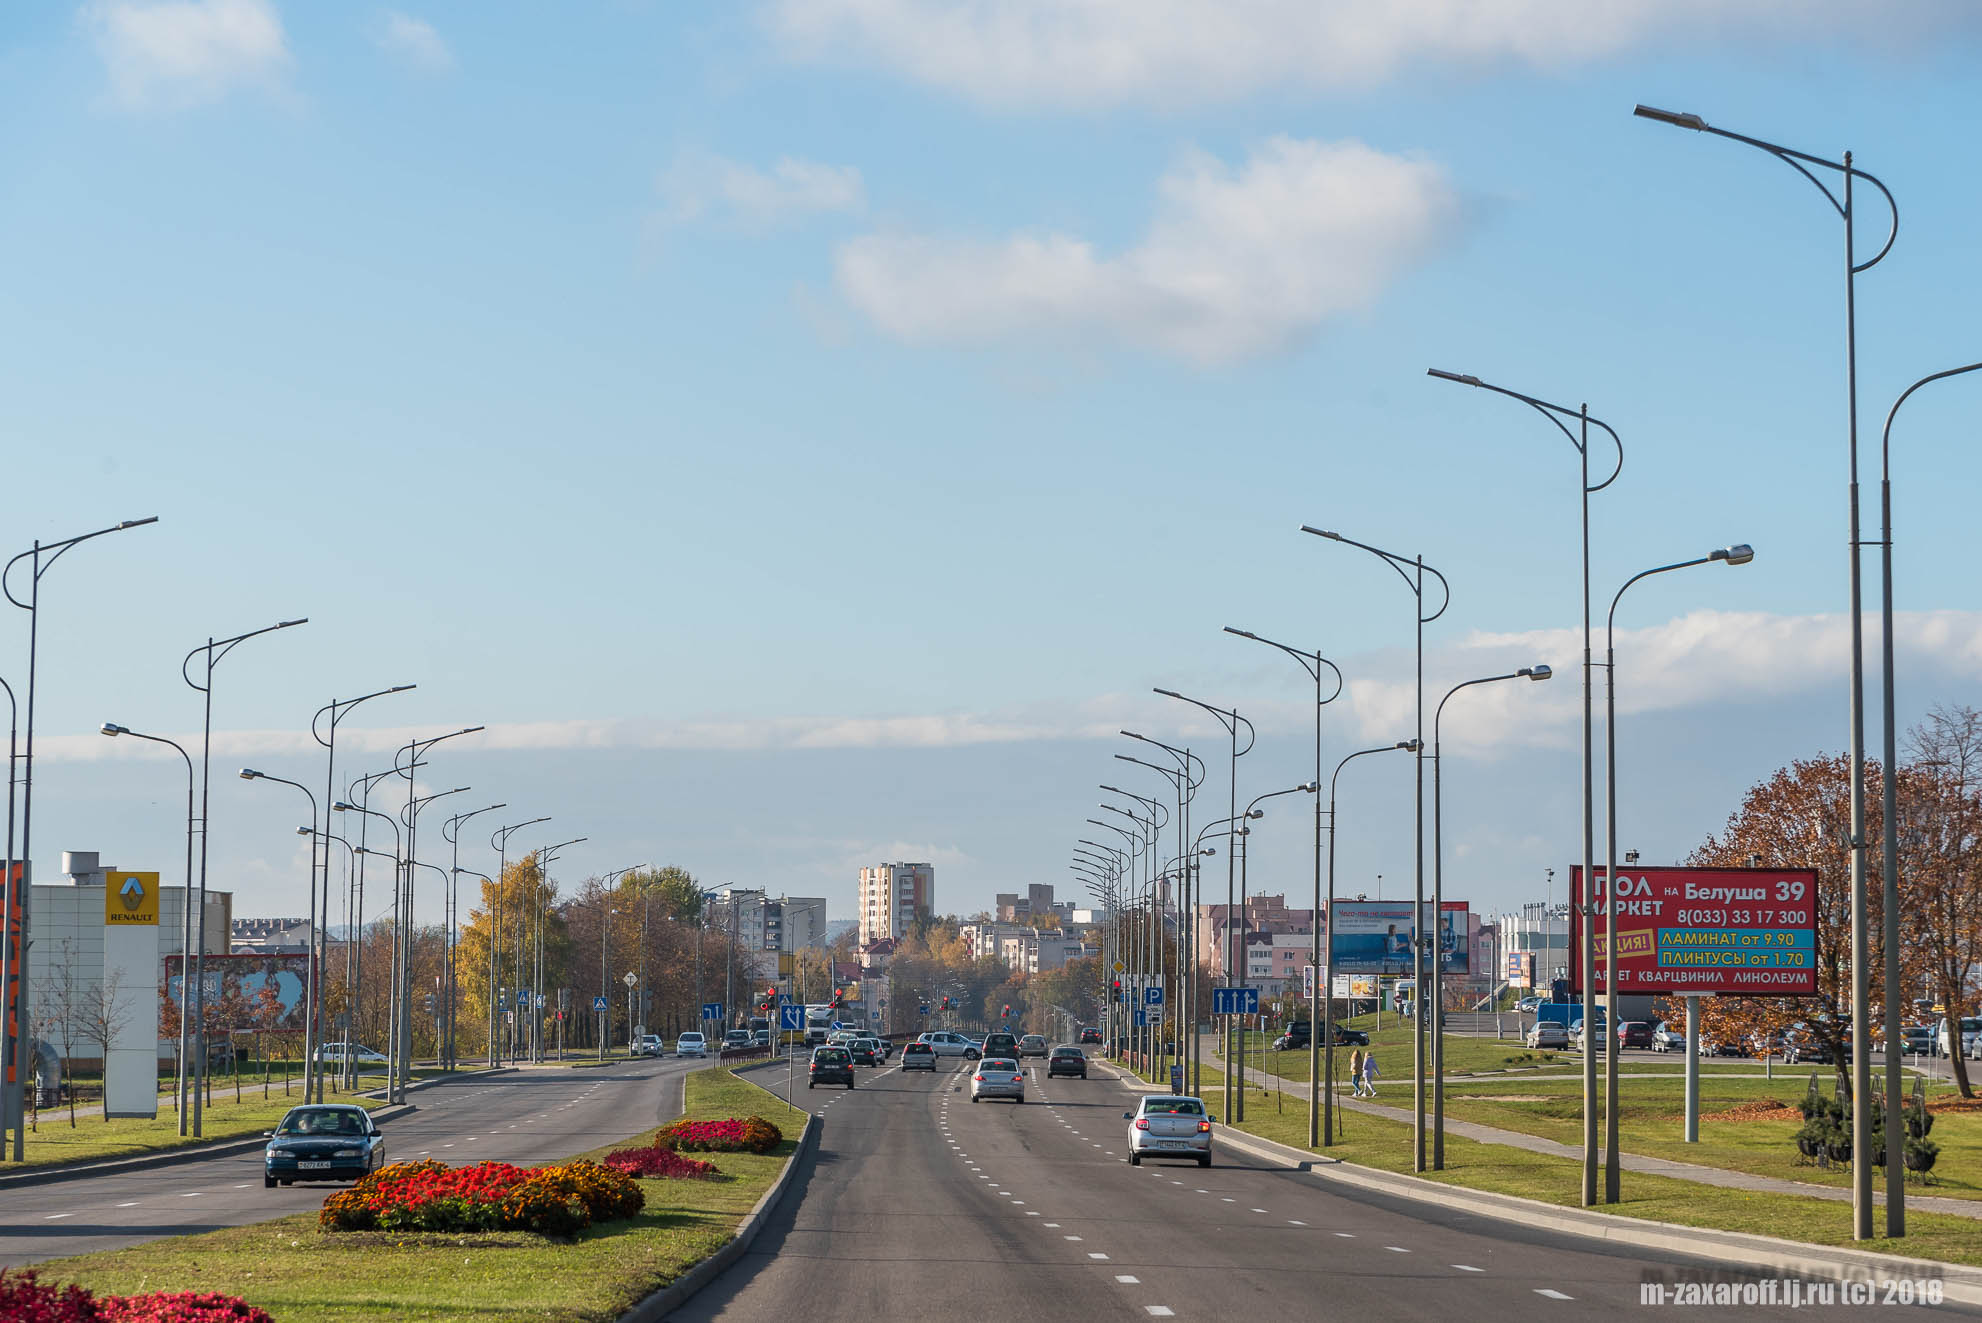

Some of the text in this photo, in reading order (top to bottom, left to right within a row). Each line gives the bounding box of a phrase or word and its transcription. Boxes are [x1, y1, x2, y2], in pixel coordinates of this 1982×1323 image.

[1595, 876, 1653, 896] ПОЛ
[1685, 883, 1766, 904] Белуша
[1775, 881, 1805, 901] 39
[111, 913, 153, 921] RENAULT
[1677, 909, 1806, 926] 8(033) 33 17 300
[1661, 932, 1794, 946] ЛАМИНАТ от 9.90
[1662, 951, 1804, 966] ПЛИНТУСЫ от 1.70
[1638, 971, 1724, 983] КВАРЦВИНИЛ
[1733, 972, 1808, 984] ЛИНОЛЕУМ
[1150, 989, 1160, 1003] P
